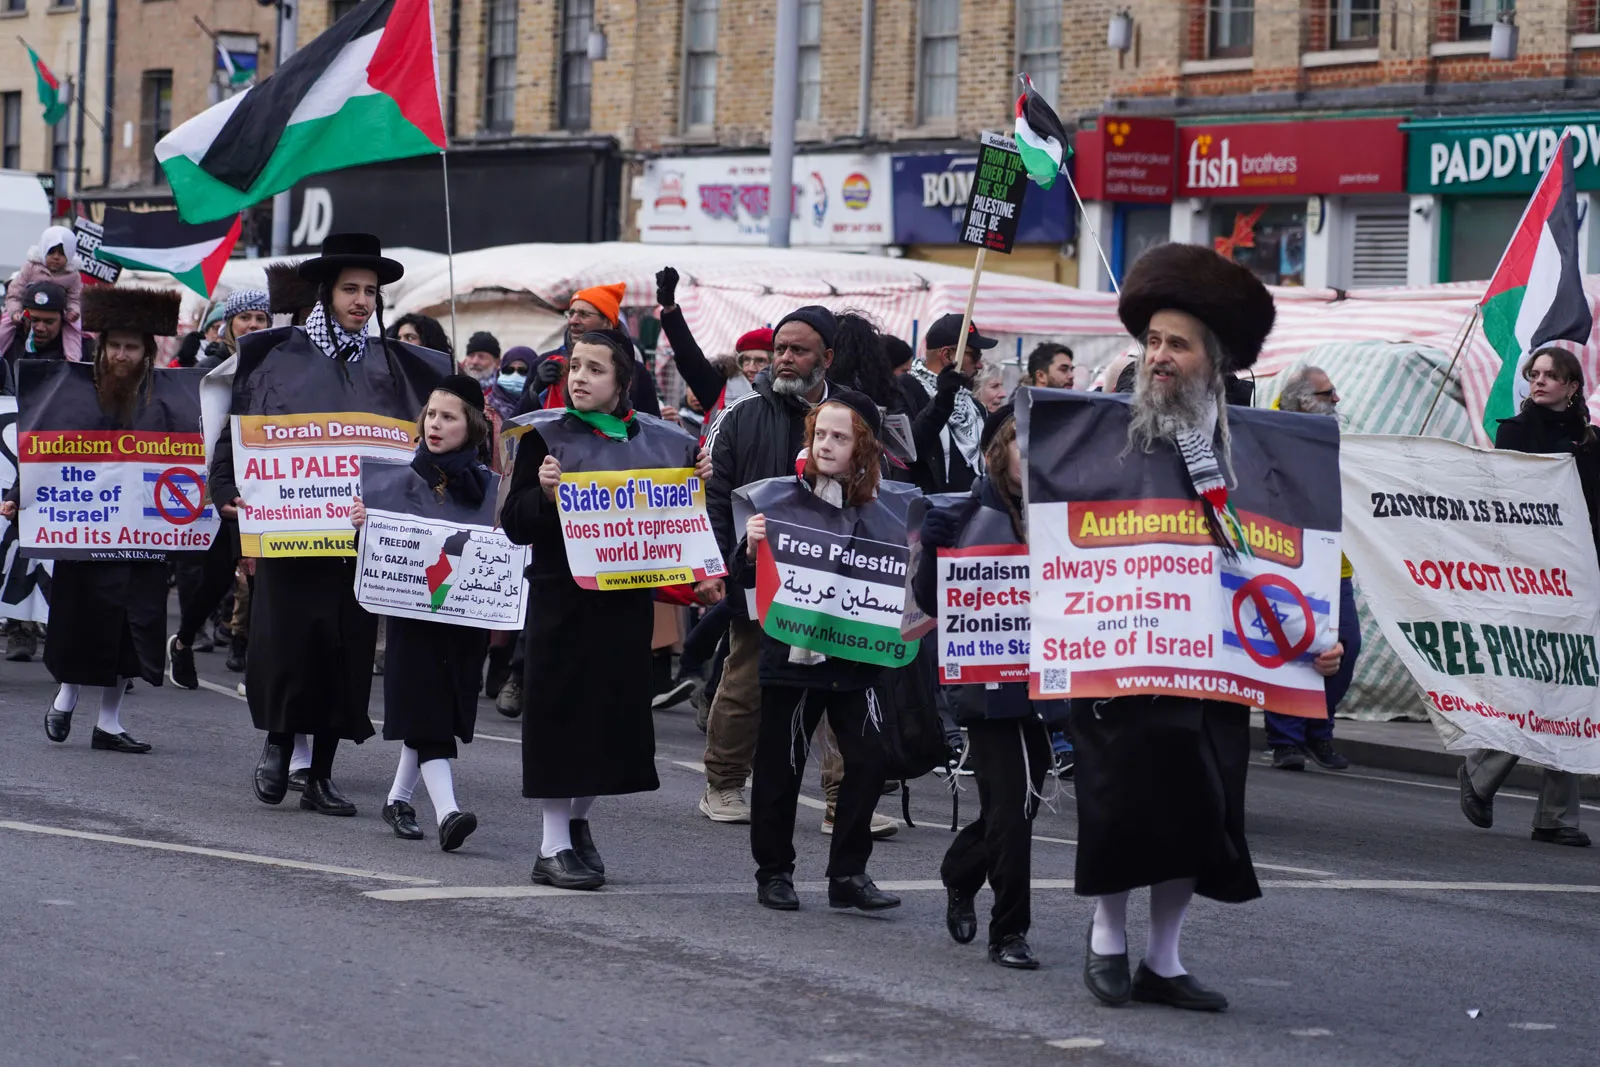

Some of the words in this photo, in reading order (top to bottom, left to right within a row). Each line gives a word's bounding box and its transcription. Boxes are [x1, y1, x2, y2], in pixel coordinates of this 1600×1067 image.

[989, 136, 1009, 149] Socialist
[984, 147, 1006, 166] FROM
[1007, 153, 1023, 172] THE
[1187, 138, 1239, 188] fish
[1242, 153, 1297, 175] brothers
[980, 164, 1003, 183] RIVER
[1004, 170, 1016, 185] TO
[977, 179, 990, 196] THE
[992, 183, 1008, 201] SEA
[291, 187, 334, 247] JD
[972, 194, 1016, 219] PALESTINE
[969, 210, 986, 228] WILL
[988, 215, 1000, 231] BE
[76, 230, 103, 251] FREE
[964, 226, 986, 244] FREE
[263, 422, 322, 440] Torah
[328, 422, 409, 443] Demands
[27, 434, 113, 455] Judaism
[61, 466, 96, 482] the
[244, 457, 286, 481] ALL
[291, 455, 360, 478] PALES
[36, 486, 93, 502] State
[99, 486, 122, 502] of
[280, 485, 295, 500] be
[298, 484, 352, 499] returned
[558, 482, 611, 513] State
[615, 479, 635, 510] of
[638, 477, 699, 508] "Israel"
[245, 504, 323, 521] Palestinian
[1371, 492, 1470, 521] ZIONISM
[1472, 500, 1491, 522] IS
[1491, 500, 1564, 526] RACISM
[370, 521, 399, 532] Judaism
[400, 525, 433, 536] Demands
[565, 520, 600, 540] does
[604, 517, 635, 538] not
[638, 514, 709, 540] represent
[1079, 509, 1210, 538] Authentic
[35, 527, 78, 545] And
[84, 527, 112, 544] its
[117, 527, 211, 546] Atrocities
[269, 537, 355, 551] www.nkus
[379, 537, 420, 550] FREEDOM
[91, 551, 166, 562] www.NKUSA.org
[371, 553, 383, 562] for
[385, 554, 408, 566] GAZA
[409, 559, 424, 568] and
[474, 547, 511, 565] الحرية
[595, 541, 639, 563] world
[642, 541, 682, 563] Jewry
[778, 533, 823, 558] Free
[828, 543, 907, 576] Palestin
[363, 568, 378, 579] ALL
[381, 570, 428, 585] PALESTINE
[478, 565, 495, 577] غزة
[946, 561, 1030, 582] Judaism
[1042, 555, 1116, 584] always
[1124, 551, 1213, 579] opposed
[1403, 559, 1506, 593] BOYCOTT
[1506, 566, 1573, 597] ISRAEL
[459, 578, 502, 593] فلسطين
[605, 572, 687, 586] www.NKUSA.org
[784, 569, 836, 605] عربية
[368, 583, 385, 593] forbids
[386, 586, 395, 594] any
[396, 587, 411, 596] Jewish
[411, 588, 425, 597] State
[504, 584, 519, 597] كل
[946, 587, 1031, 611] Rejects
[415, 601, 466, 615] www.nkusa.org
[1063, 587, 1191, 615] Zionism
[946, 613, 1031, 633] Zionism
[1097, 616, 1127, 631] and
[1133, 614, 1159, 629] the
[776, 616, 906, 660] www.nkusa.org
[947, 641, 975, 657] And
[979, 639, 1004, 656] the
[1008, 639, 1030, 655] Sta
[1043, 638, 1106, 661] State
[1115, 632, 1137, 656] of
[1148, 631, 1213, 658] Israel
[1396, 621, 1485, 676] FREE
[1480, 624, 1599, 687] PALESTINE!
[1116, 674, 1265, 705] www.NKUSA.org
[1528, 710, 1582, 738] Communist
